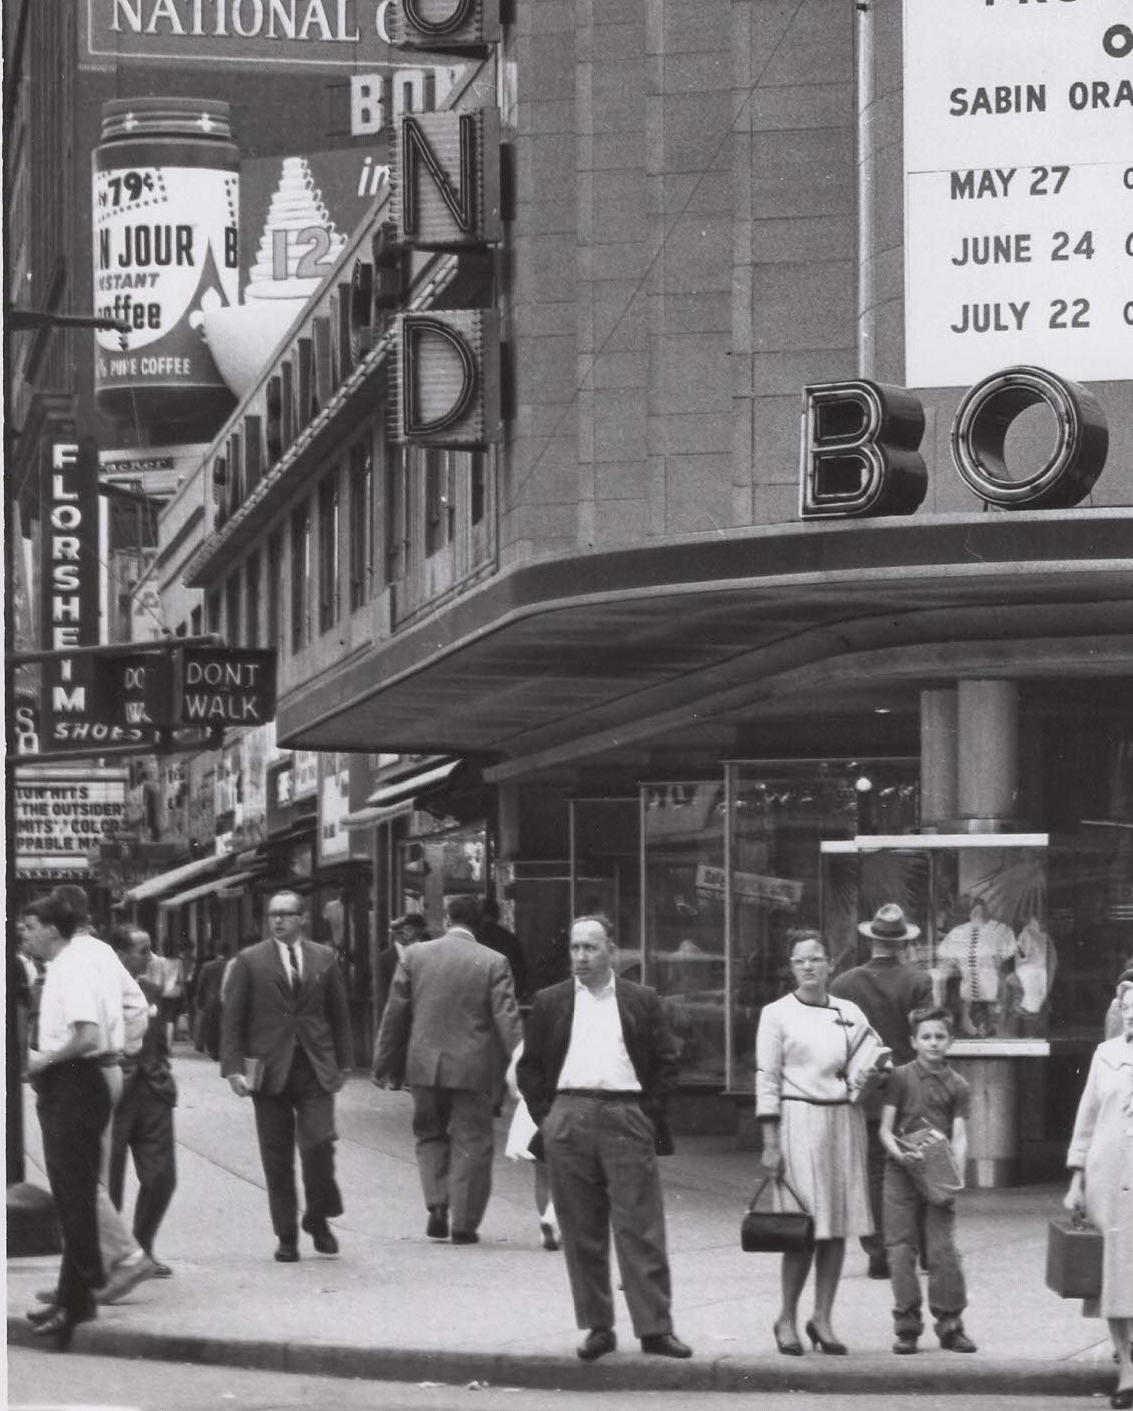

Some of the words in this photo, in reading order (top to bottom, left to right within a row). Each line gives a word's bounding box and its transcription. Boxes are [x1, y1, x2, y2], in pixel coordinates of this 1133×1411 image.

[949, 84, 1046, 117] SABIN
[950, 168, 1017, 200] MAY
[1029, 165, 1071, 196] 27
[118, 224, 195, 268] JOUR
[271, 226, 333, 282] 12
[951, 234, 1032, 266] JUNE
[1051, 230, 1095, 261] 24
[950, 301, 1030, 334] JULY
[1048, 298, 1090, 329] 22
[141, 356, 191, 376] COFFEE
[50, 443, 86, 712] FLORSHEIM
[186, 662, 260, 688] DONT
[186, 693, 260, 720] WALK
